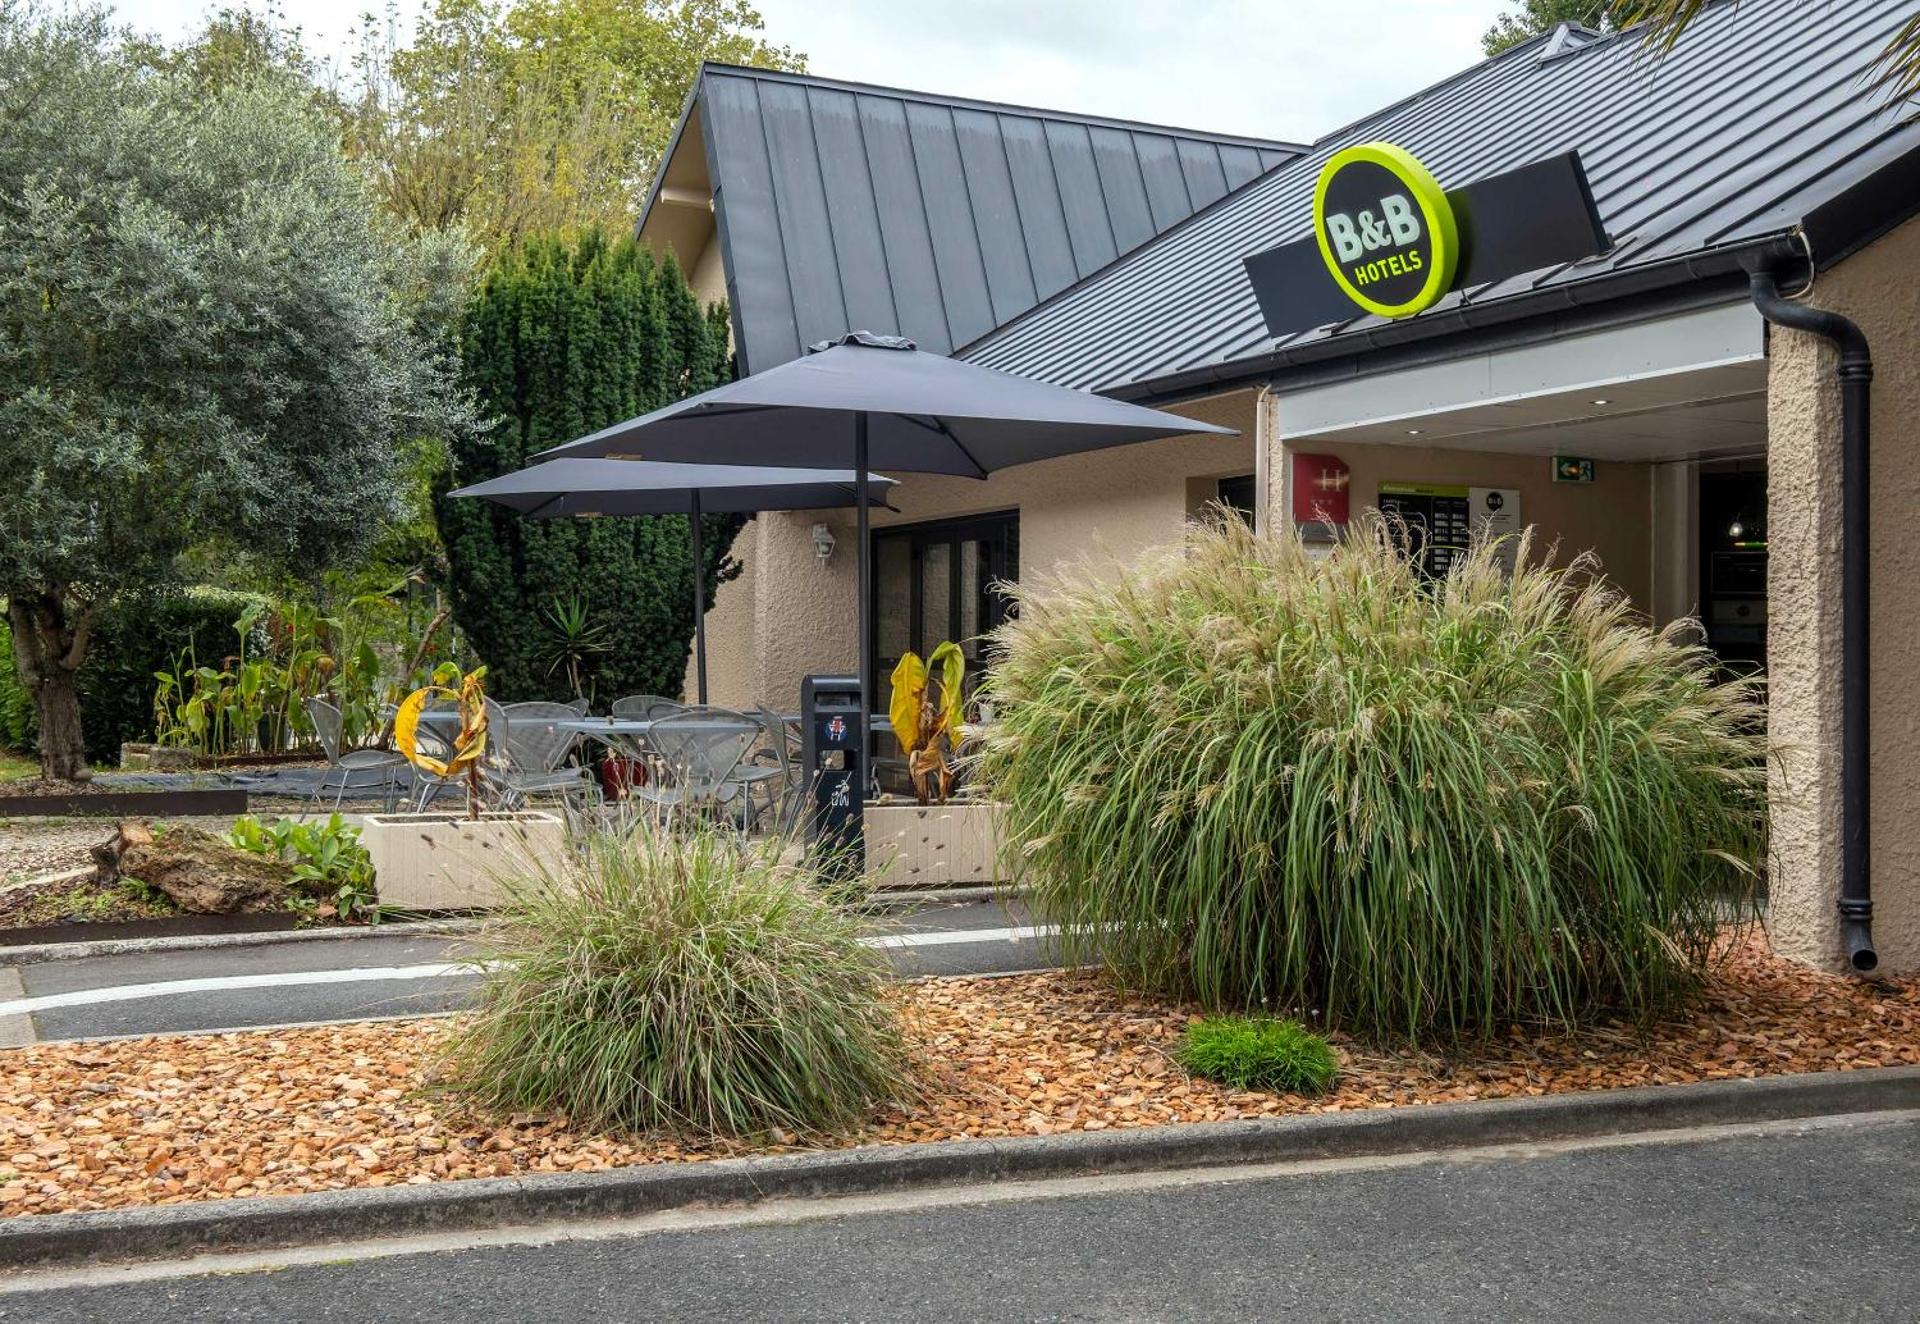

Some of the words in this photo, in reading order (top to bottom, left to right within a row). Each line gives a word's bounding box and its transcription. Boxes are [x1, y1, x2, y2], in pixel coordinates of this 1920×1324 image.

[1326, 194, 1420, 263] B&B
[1354, 250, 1423, 285] HOTELS
[1322, 468, 1340, 492] H
